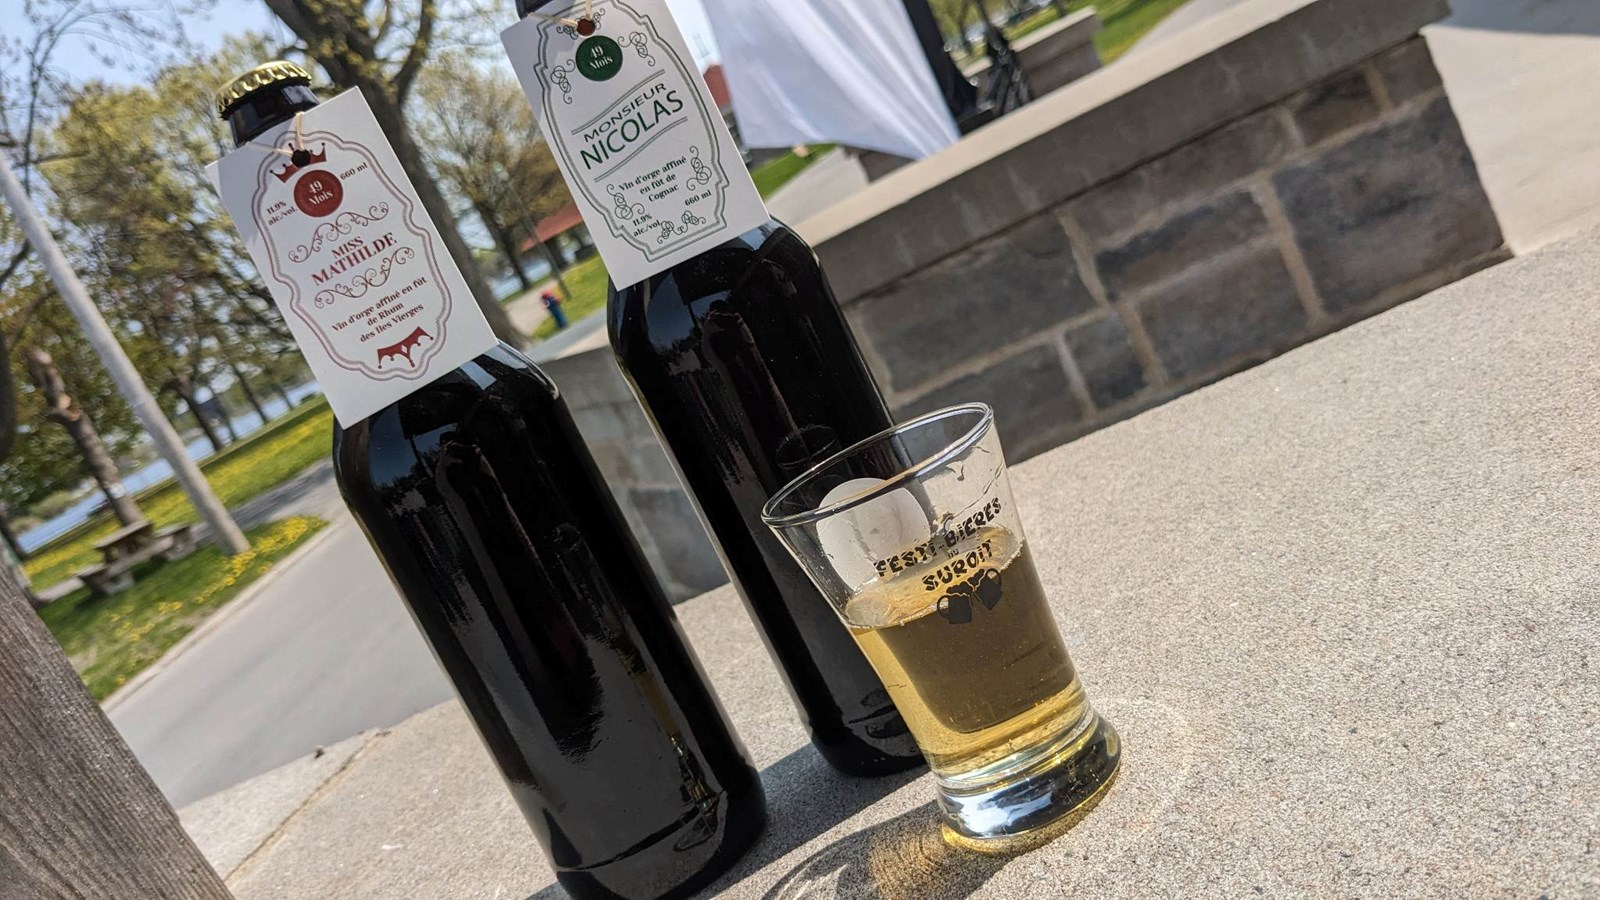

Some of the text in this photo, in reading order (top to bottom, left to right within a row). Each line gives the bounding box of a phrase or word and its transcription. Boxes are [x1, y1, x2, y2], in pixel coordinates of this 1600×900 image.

[590, 45, 605, 58] 49
[590, 56, 613, 69] Mois
[583, 83, 667, 142] MONSIEUR
[580, 90, 683, 170] NICOLAS
[339, 162, 368, 180] 660 ml
[619, 156, 687, 191] Vin d'orge affiné
[309, 180, 323, 193] 49
[640, 173, 676, 195] en fût de
[648, 184, 679, 203] Cognac
[266, 200, 287, 215] 11.9%
[308, 190, 333, 206] Mois
[684, 189, 712, 207] 660 ml
[632, 213, 652, 227] 11.9%
[331, 236, 364, 259] MISS
[311, 232, 398, 286] MATHILDE
[331, 276, 427, 332] Vin d'orge affiné en fût
[367, 302, 404, 326] de Rhum
[360, 331, 376, 342] des
[391, 304, 424, 324] Vierges
